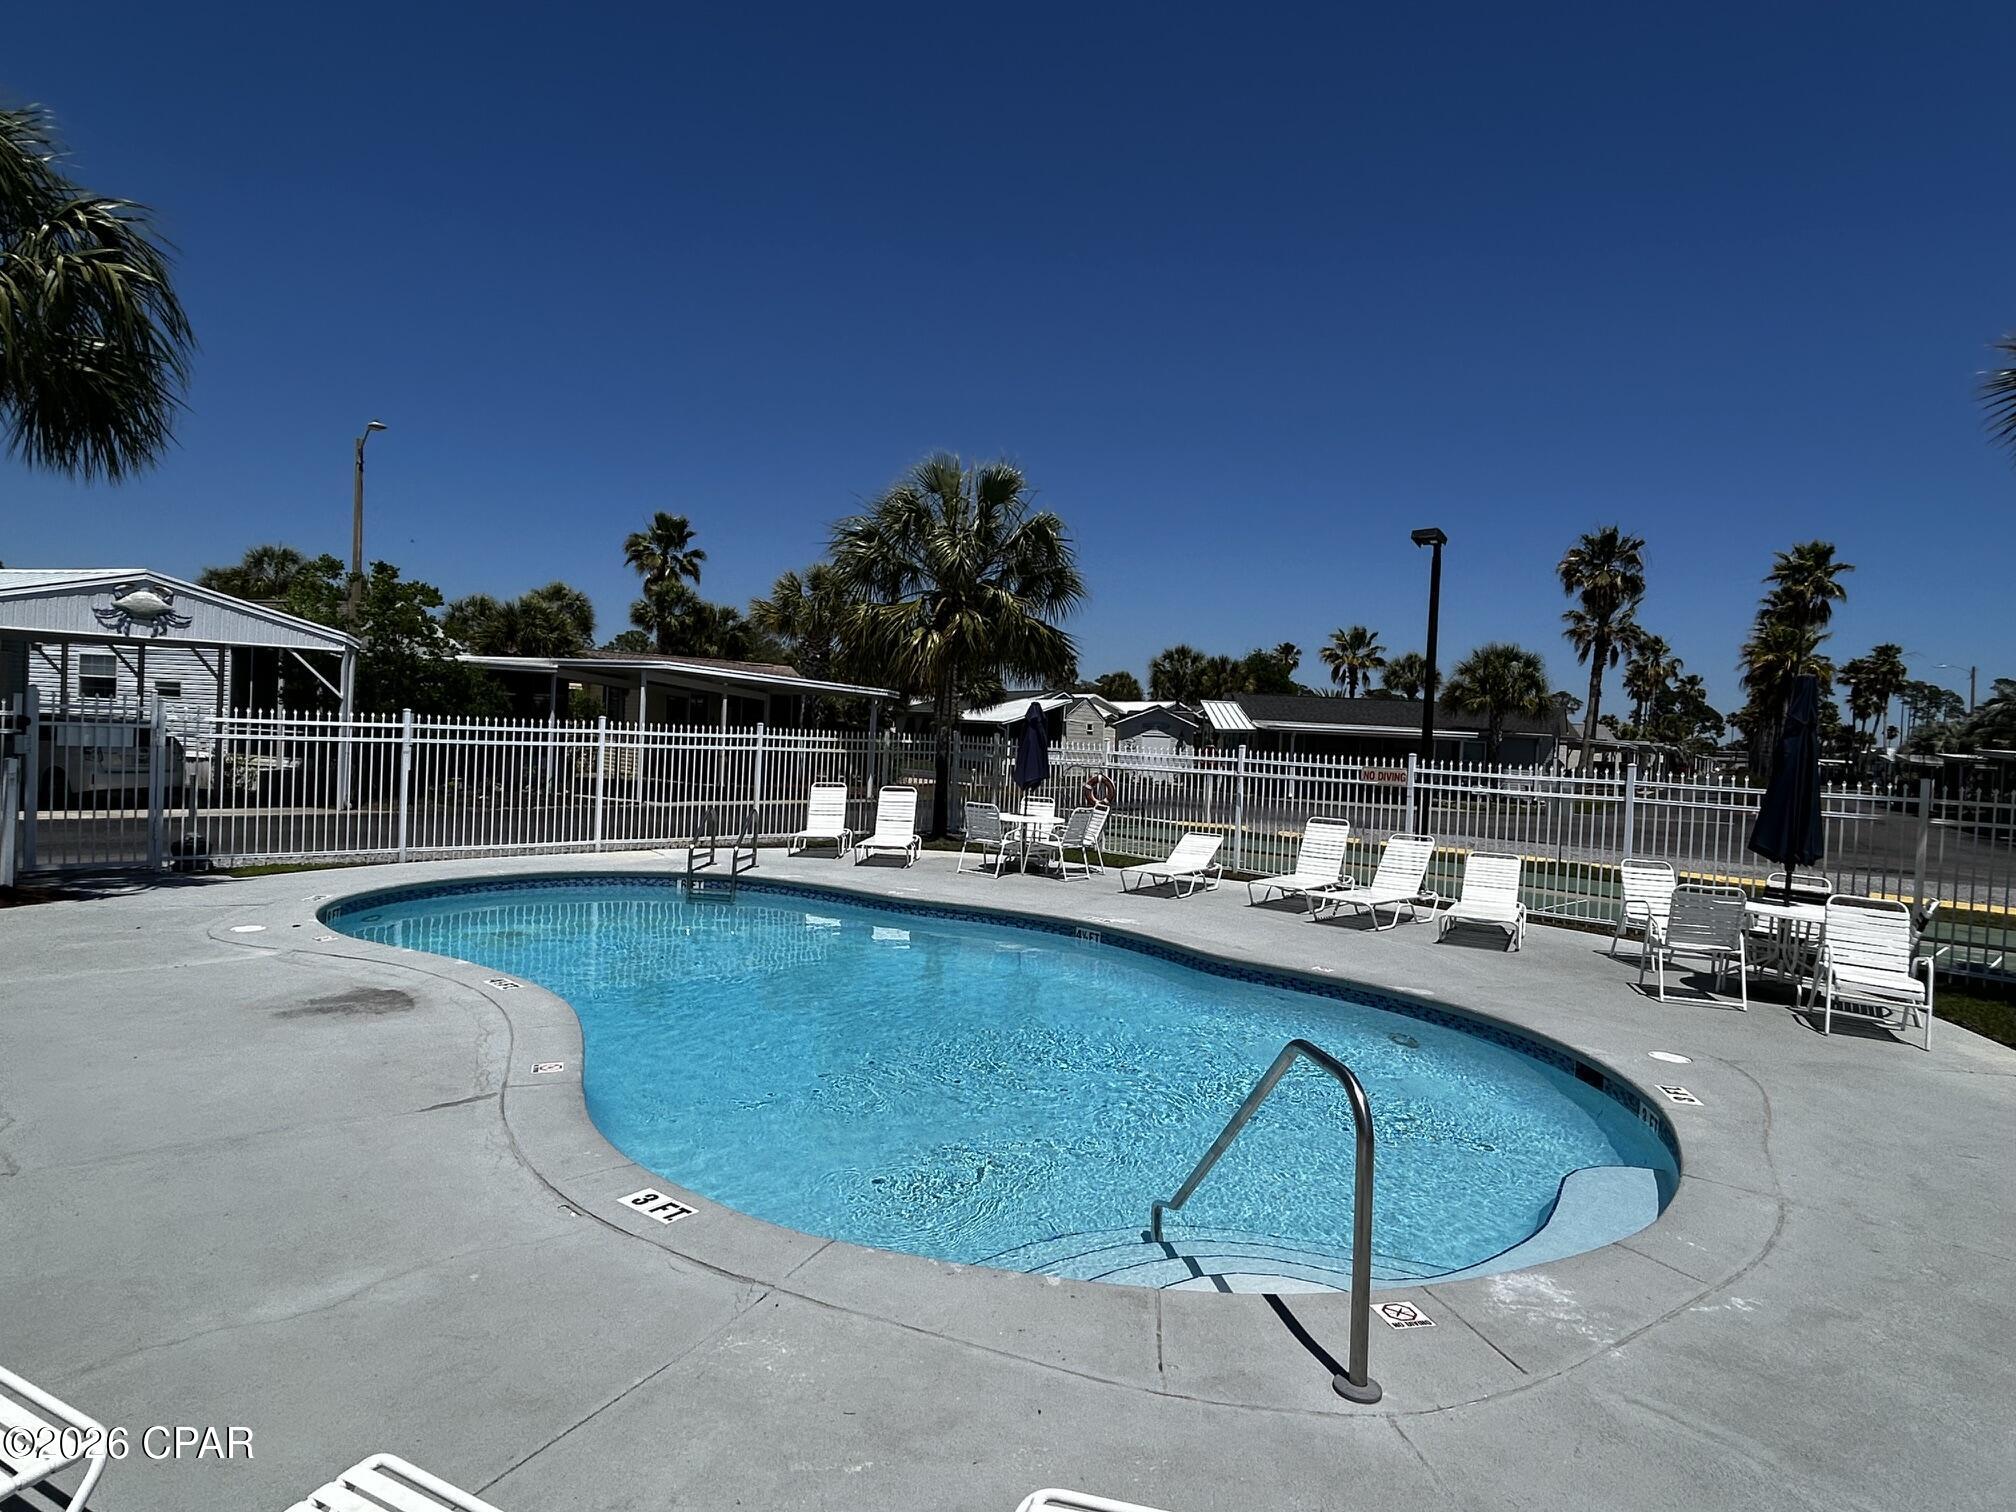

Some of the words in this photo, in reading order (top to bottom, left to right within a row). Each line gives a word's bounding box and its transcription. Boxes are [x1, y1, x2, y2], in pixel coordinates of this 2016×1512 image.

[1363, 771, 1375, 780] NO
[1377, 771, 1406, 782] DIVING
[631, 1194, 660, 1206] 3
[648, 1202, 693, 1221] FT.
